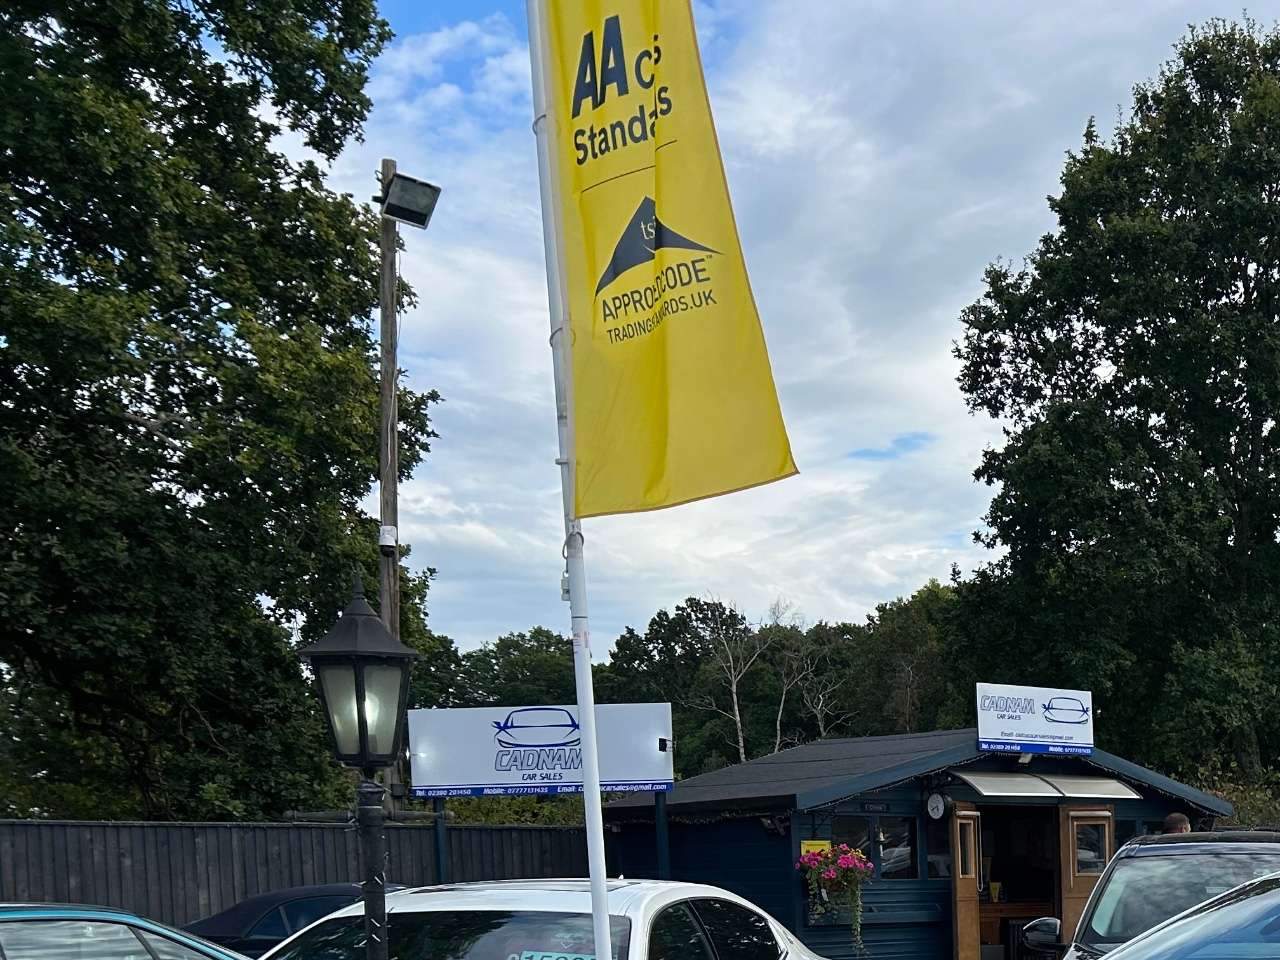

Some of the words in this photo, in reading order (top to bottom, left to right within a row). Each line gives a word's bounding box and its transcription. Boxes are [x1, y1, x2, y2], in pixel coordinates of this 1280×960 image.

[572, 14, 629, 119] AA
[981, 694, 1036, 715] CADNAM
[1006, 713, 1022, 721] SALES
[521, 773, 537, 781] CAR
[539, 772, 564, 781] SALES
